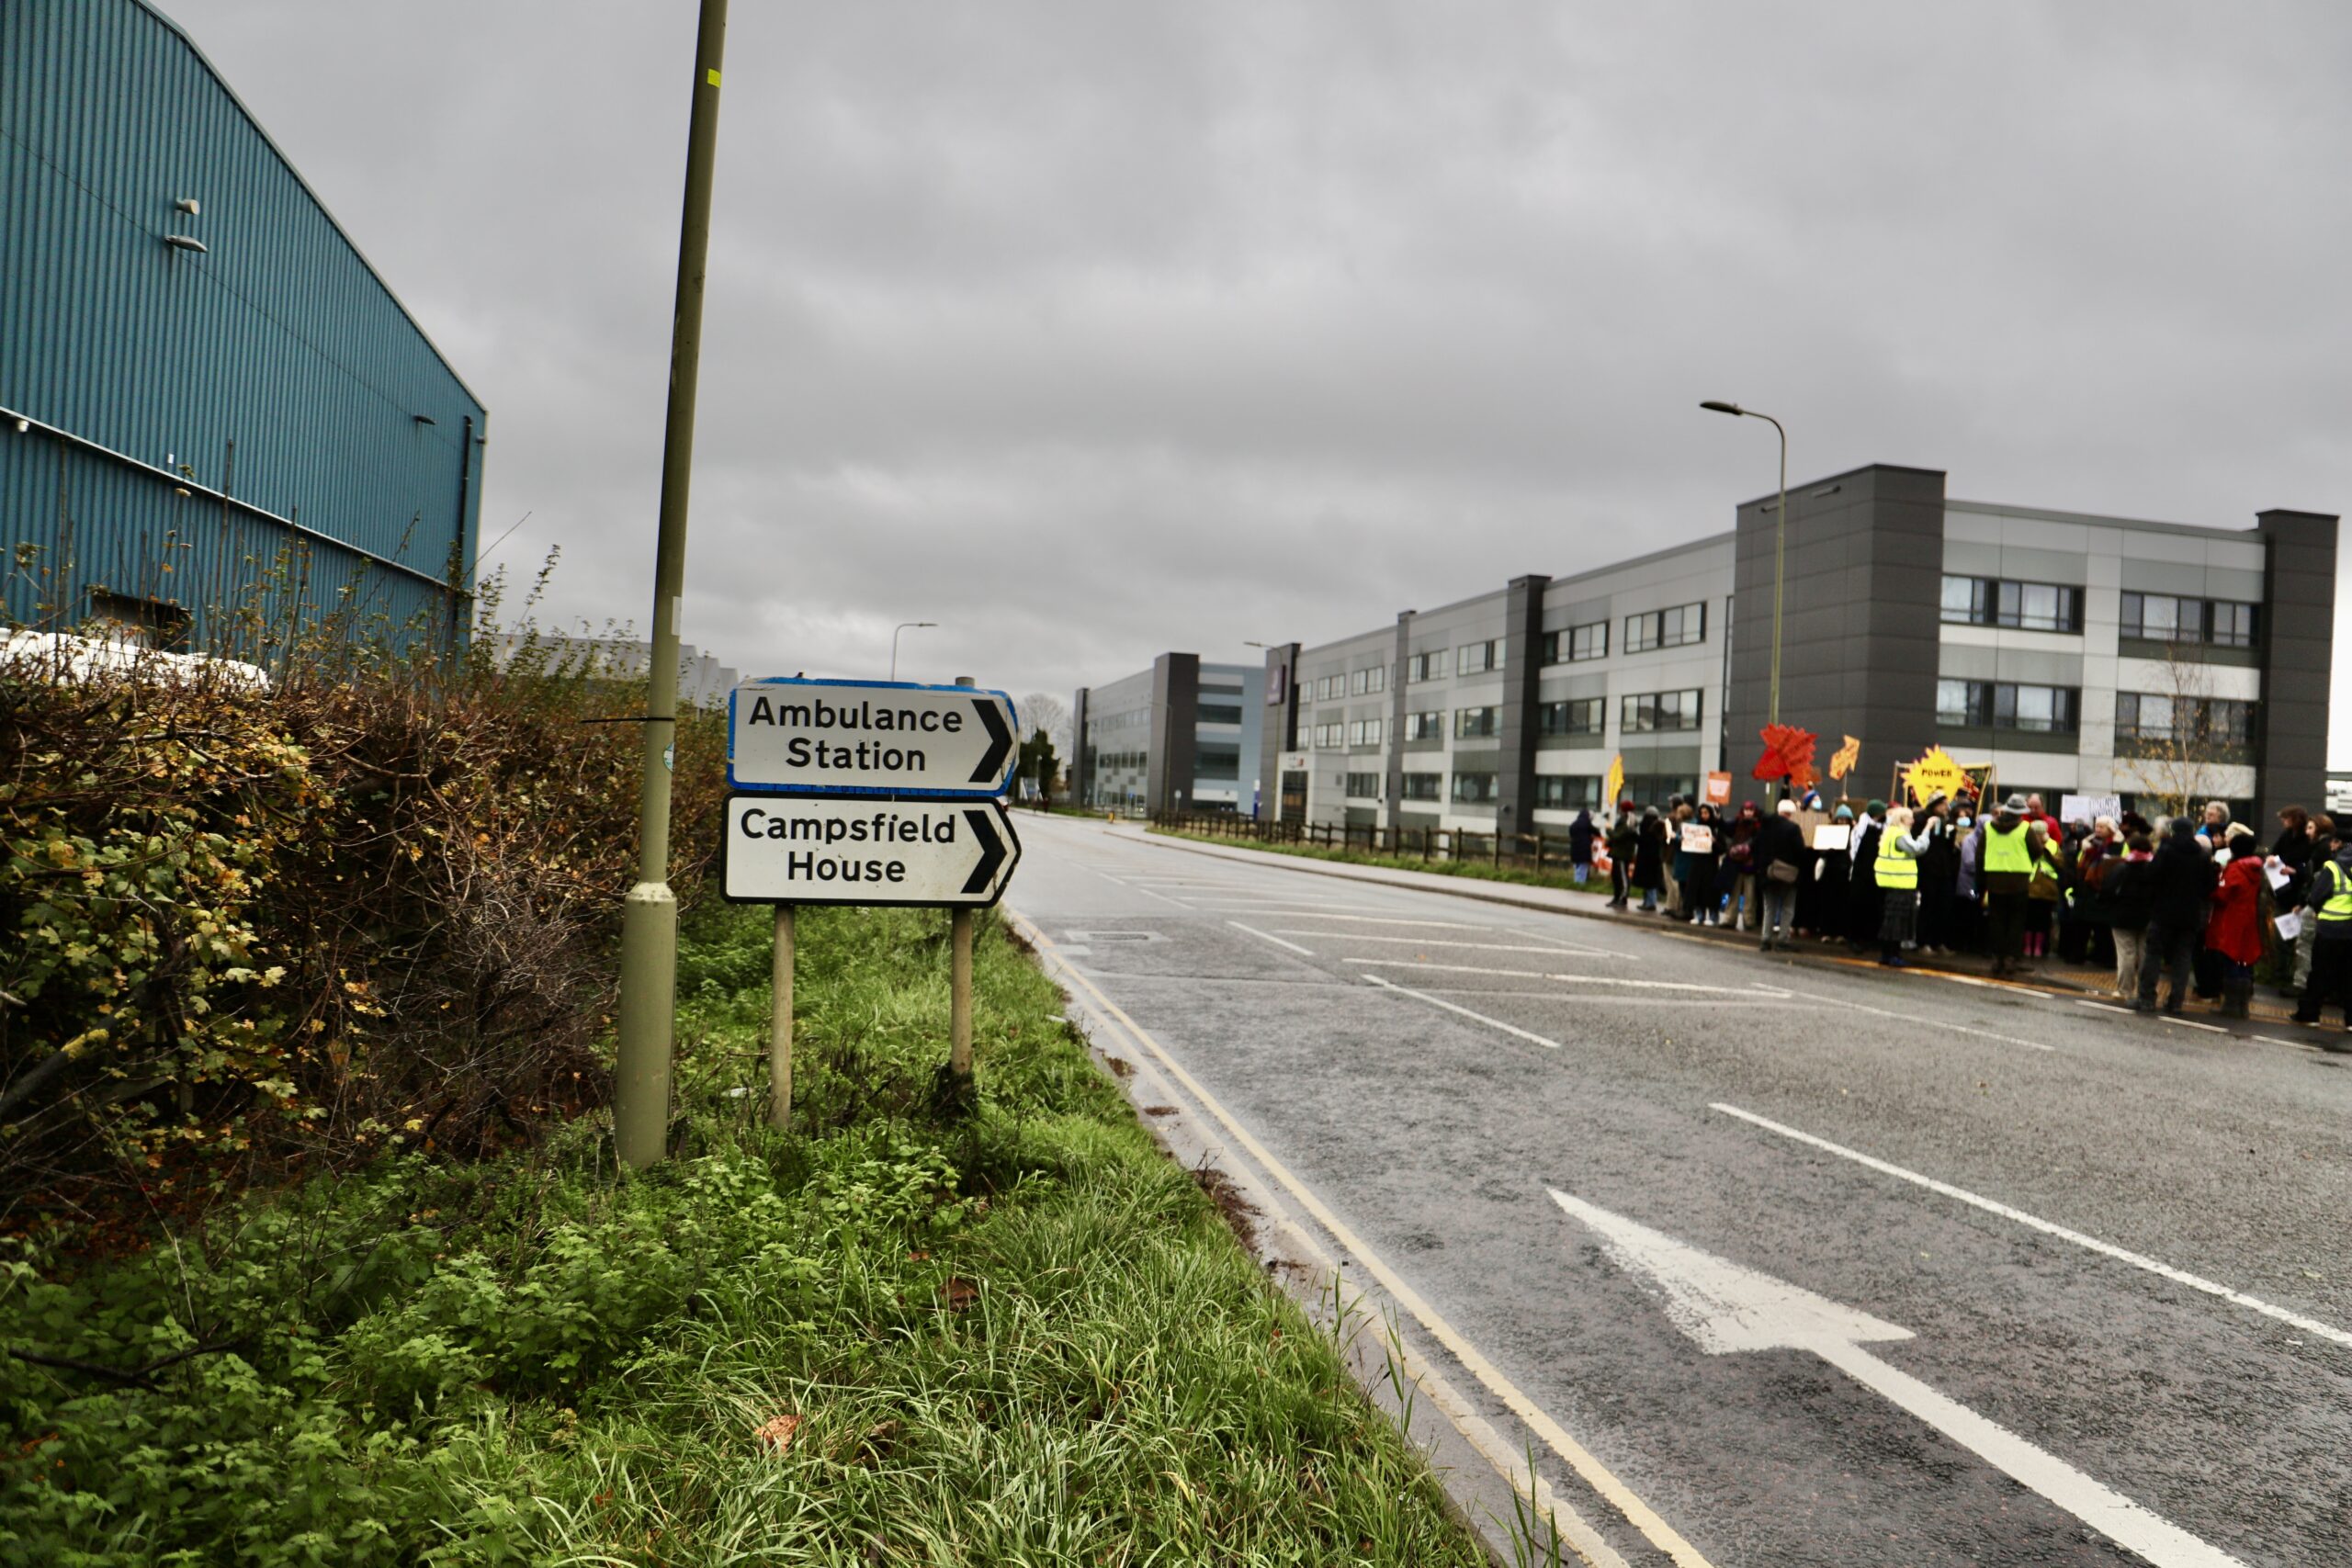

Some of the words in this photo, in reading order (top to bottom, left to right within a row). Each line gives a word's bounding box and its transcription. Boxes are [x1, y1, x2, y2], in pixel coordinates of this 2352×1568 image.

[748, 695, 963, 733] Ambulance
[786, 737, 926, 772] Station
[1921, 769, 1953, 777] POWER
[740, 807, 956, 845] Campsfield
[787, 851, 906, 883] House
